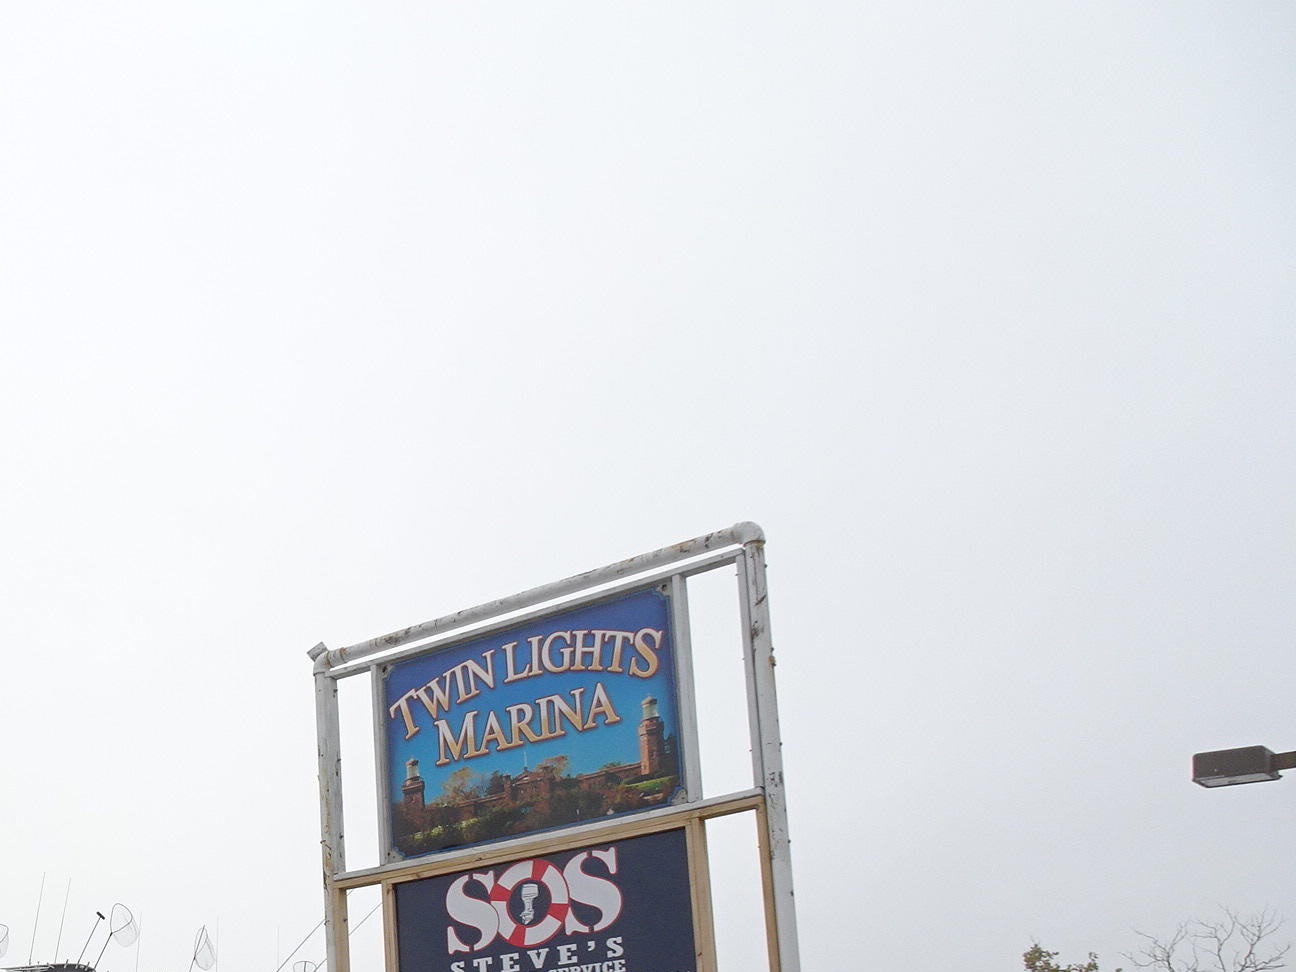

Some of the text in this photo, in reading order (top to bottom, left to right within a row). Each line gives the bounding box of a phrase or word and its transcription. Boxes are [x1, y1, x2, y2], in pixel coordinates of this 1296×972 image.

[389, 627, 664, 741] TWIN LIGHTS
[434, 682, 621, 766] MARINA
[446, 846, 623, 955] SOS
